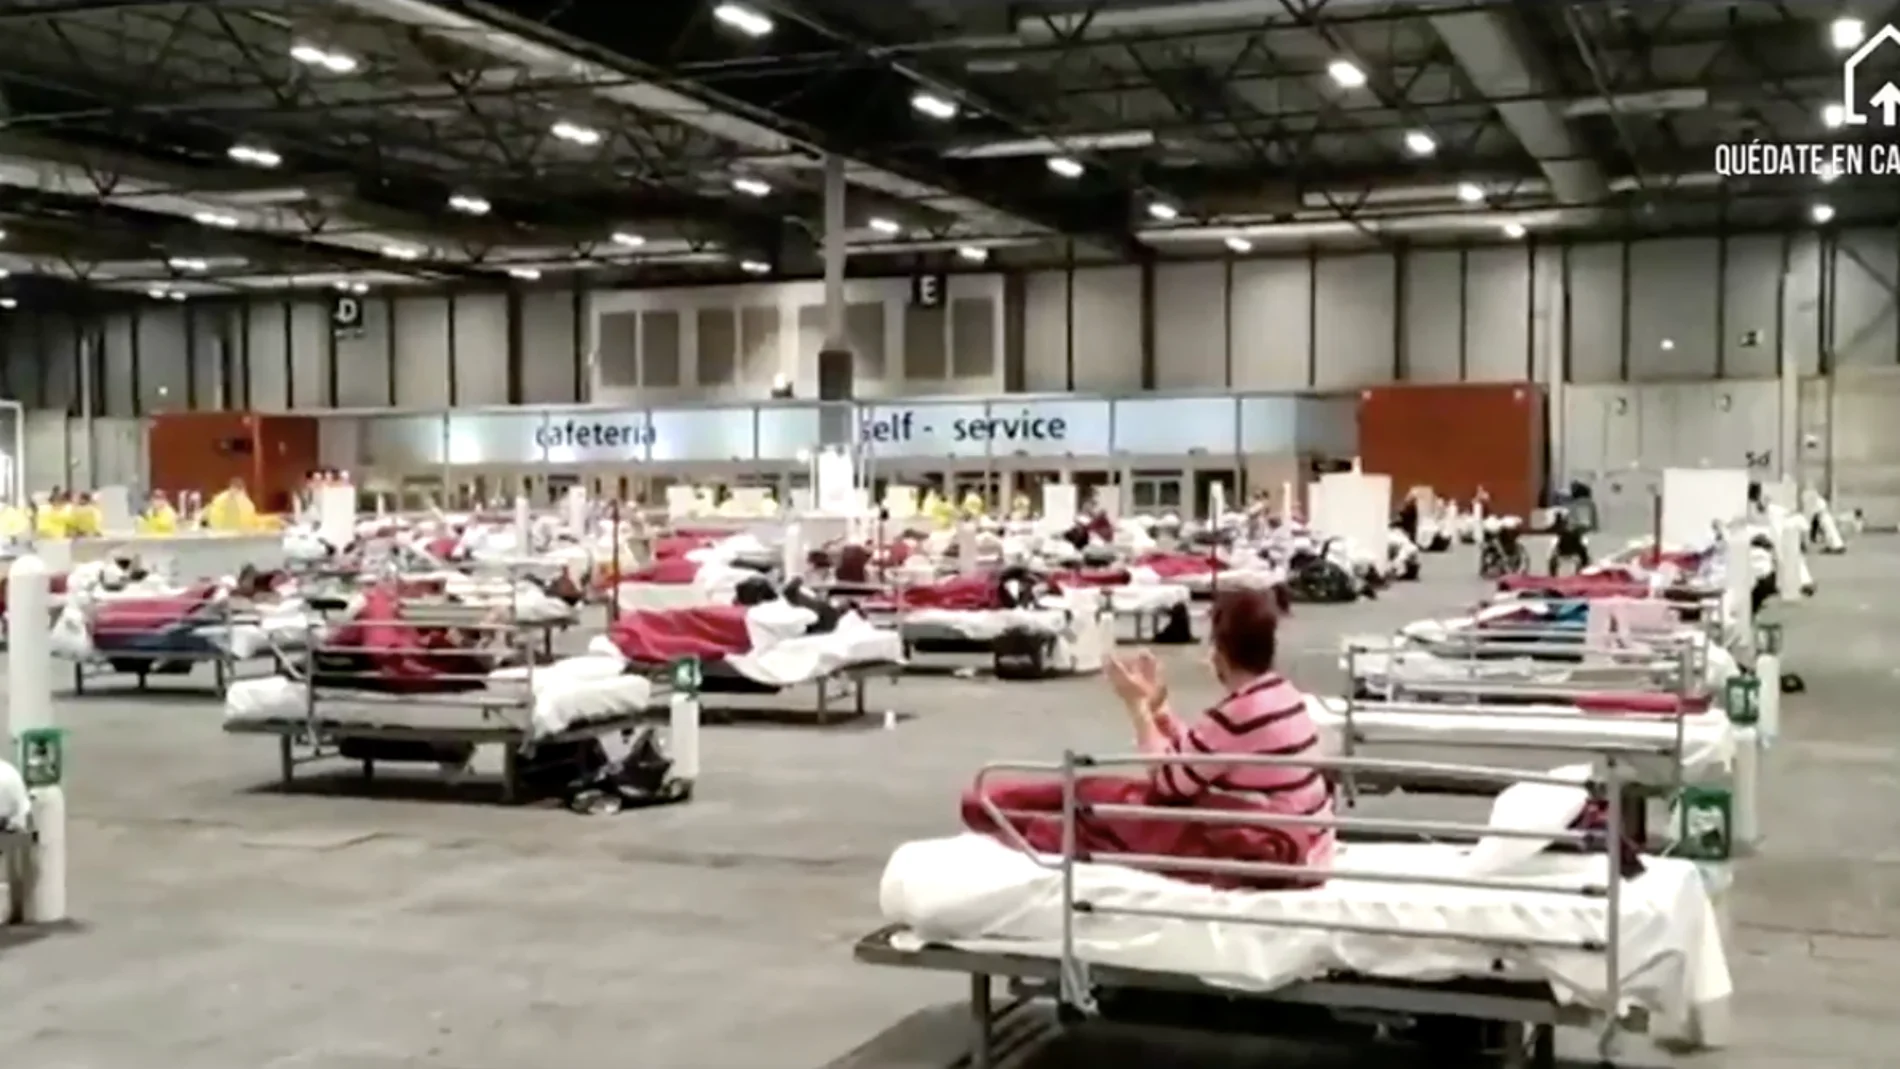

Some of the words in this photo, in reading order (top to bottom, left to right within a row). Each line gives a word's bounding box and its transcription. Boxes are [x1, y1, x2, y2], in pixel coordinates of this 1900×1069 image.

[920, 275, 937, 304] E
[338, 298, 358, 322] D
[535, 420, 656, 447] cafeteria
[953, 409, 1067, 441] service
